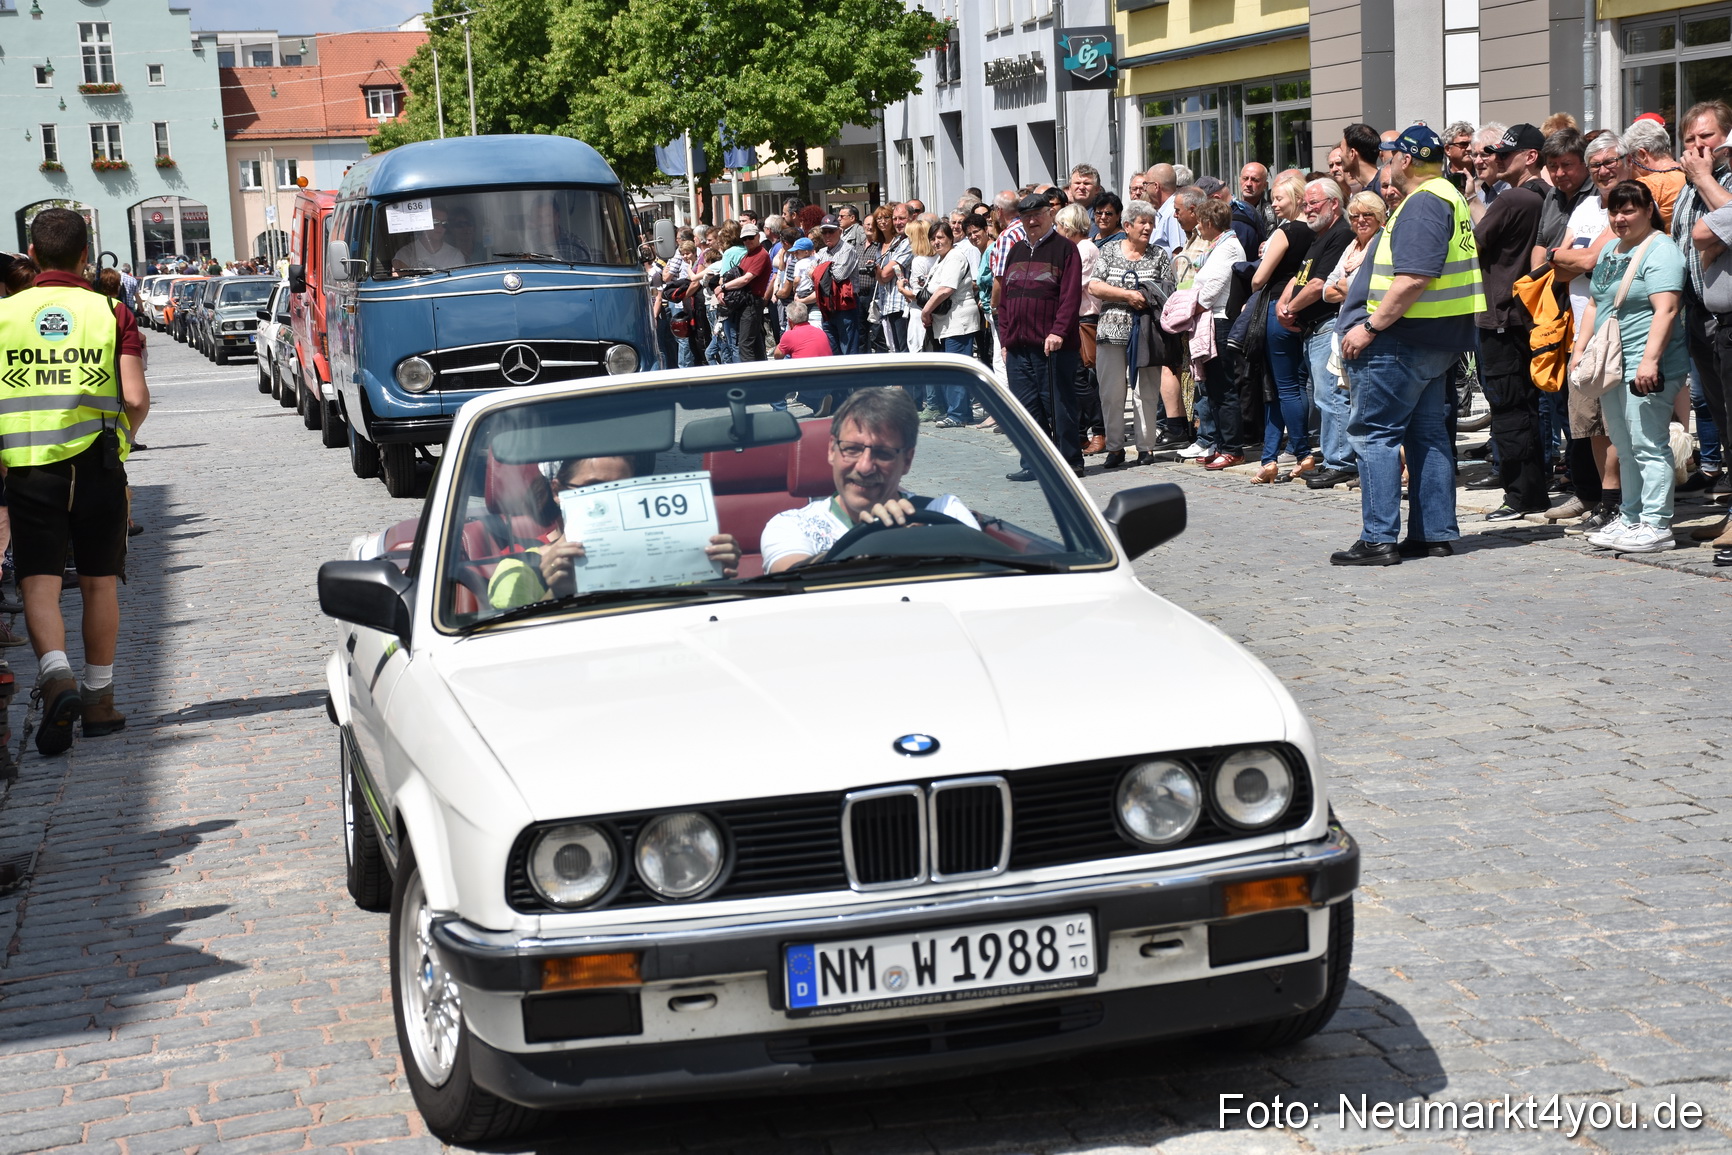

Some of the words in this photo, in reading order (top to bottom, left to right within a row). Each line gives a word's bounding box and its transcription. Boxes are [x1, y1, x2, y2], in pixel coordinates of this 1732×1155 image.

[1078, 44, 1099, 69] G2
[407, 202, 423, 211] 636
[6, 348, 103, 366] FOLLOW
[35, 369, 72, 386] ME
[638, 493, 688, 519] 169
[1066, 922, 1086, 937] 04
[796, 982, 809, 998] D
[819, 945, 876, 997] NM
[911, 939, 937, 987] W
[950, 925, 1060, 982] 1988
[1070, 954, 1088, 970] 10
[850, 995, 942, 1012] TAUFRATSHOFER
